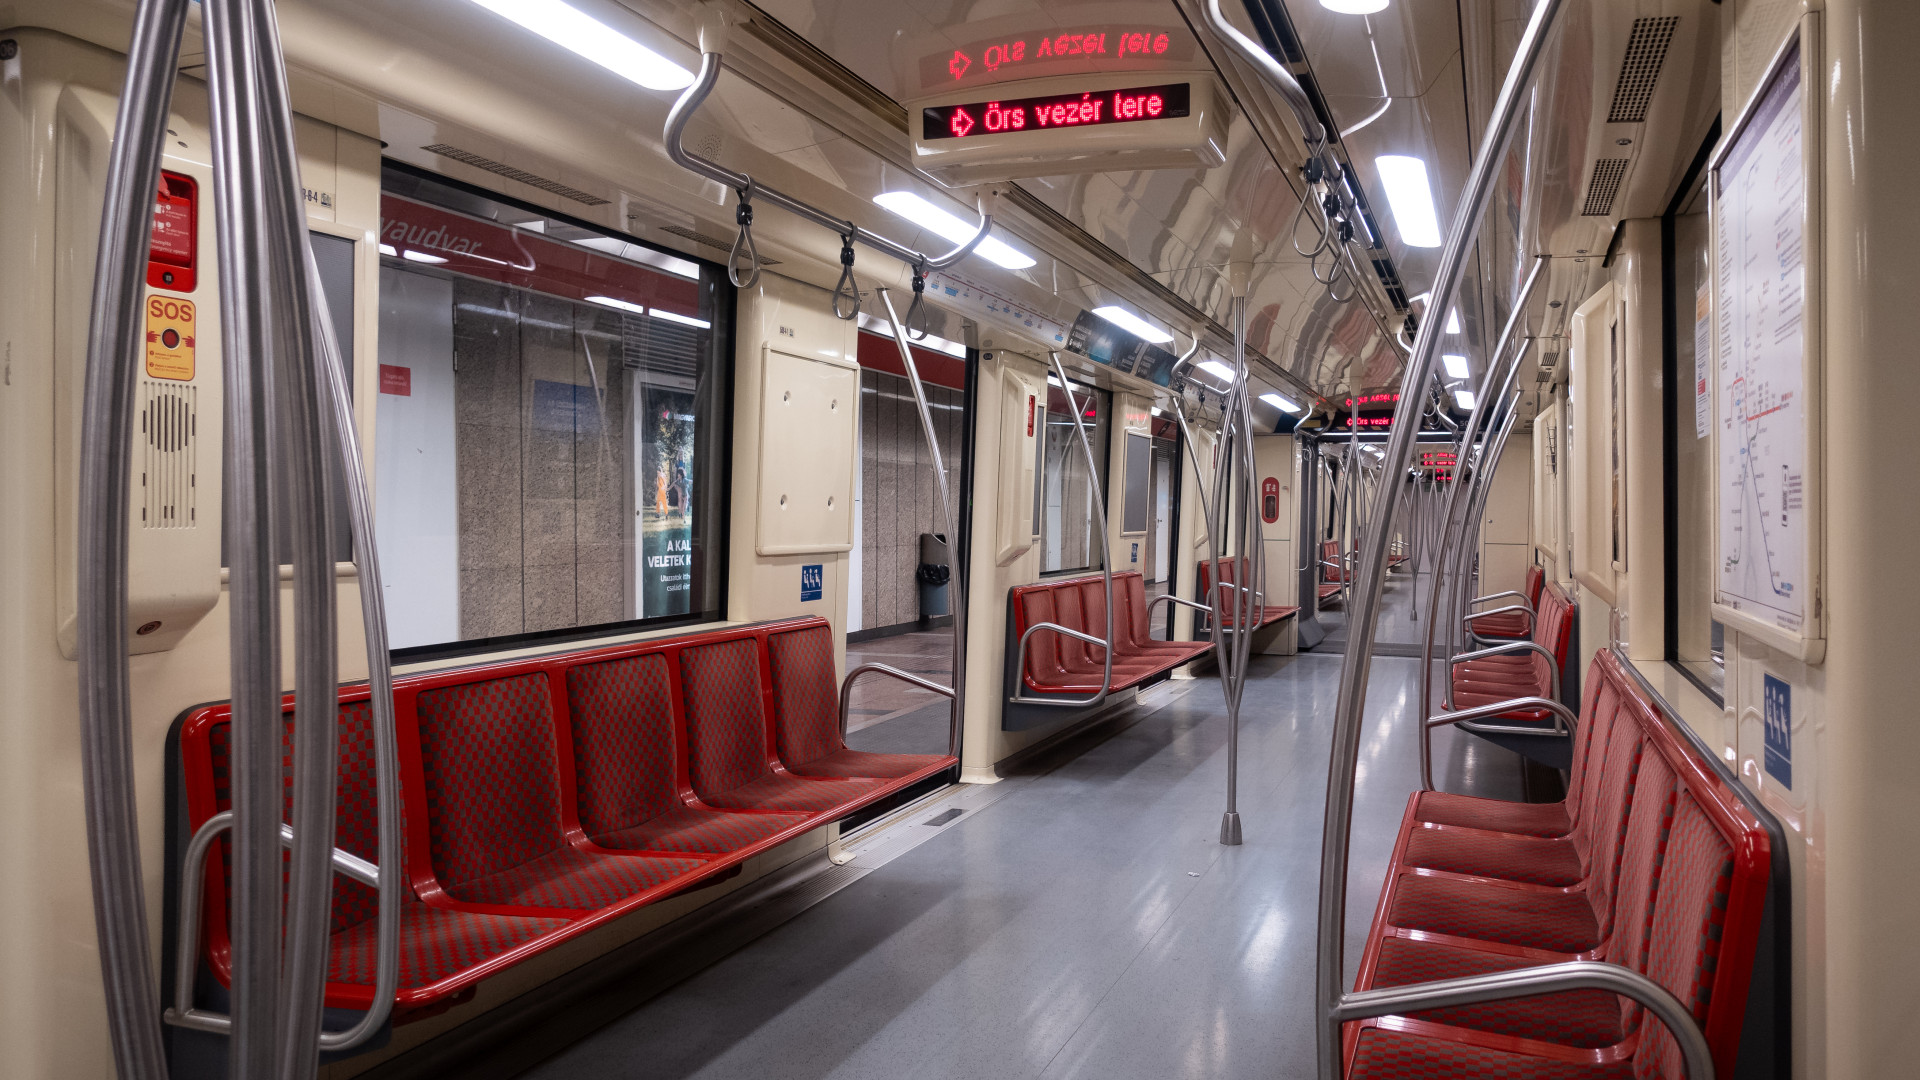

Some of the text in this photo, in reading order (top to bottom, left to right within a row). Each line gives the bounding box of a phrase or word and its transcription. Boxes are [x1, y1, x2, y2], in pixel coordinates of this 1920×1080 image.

[985, 91, 1163, 130] Örs vezér tere
[150, 300, 192, 322] SOS
[667, 540, 691, 551] A KAL
[648, 555, 684, 567] VELETEK
